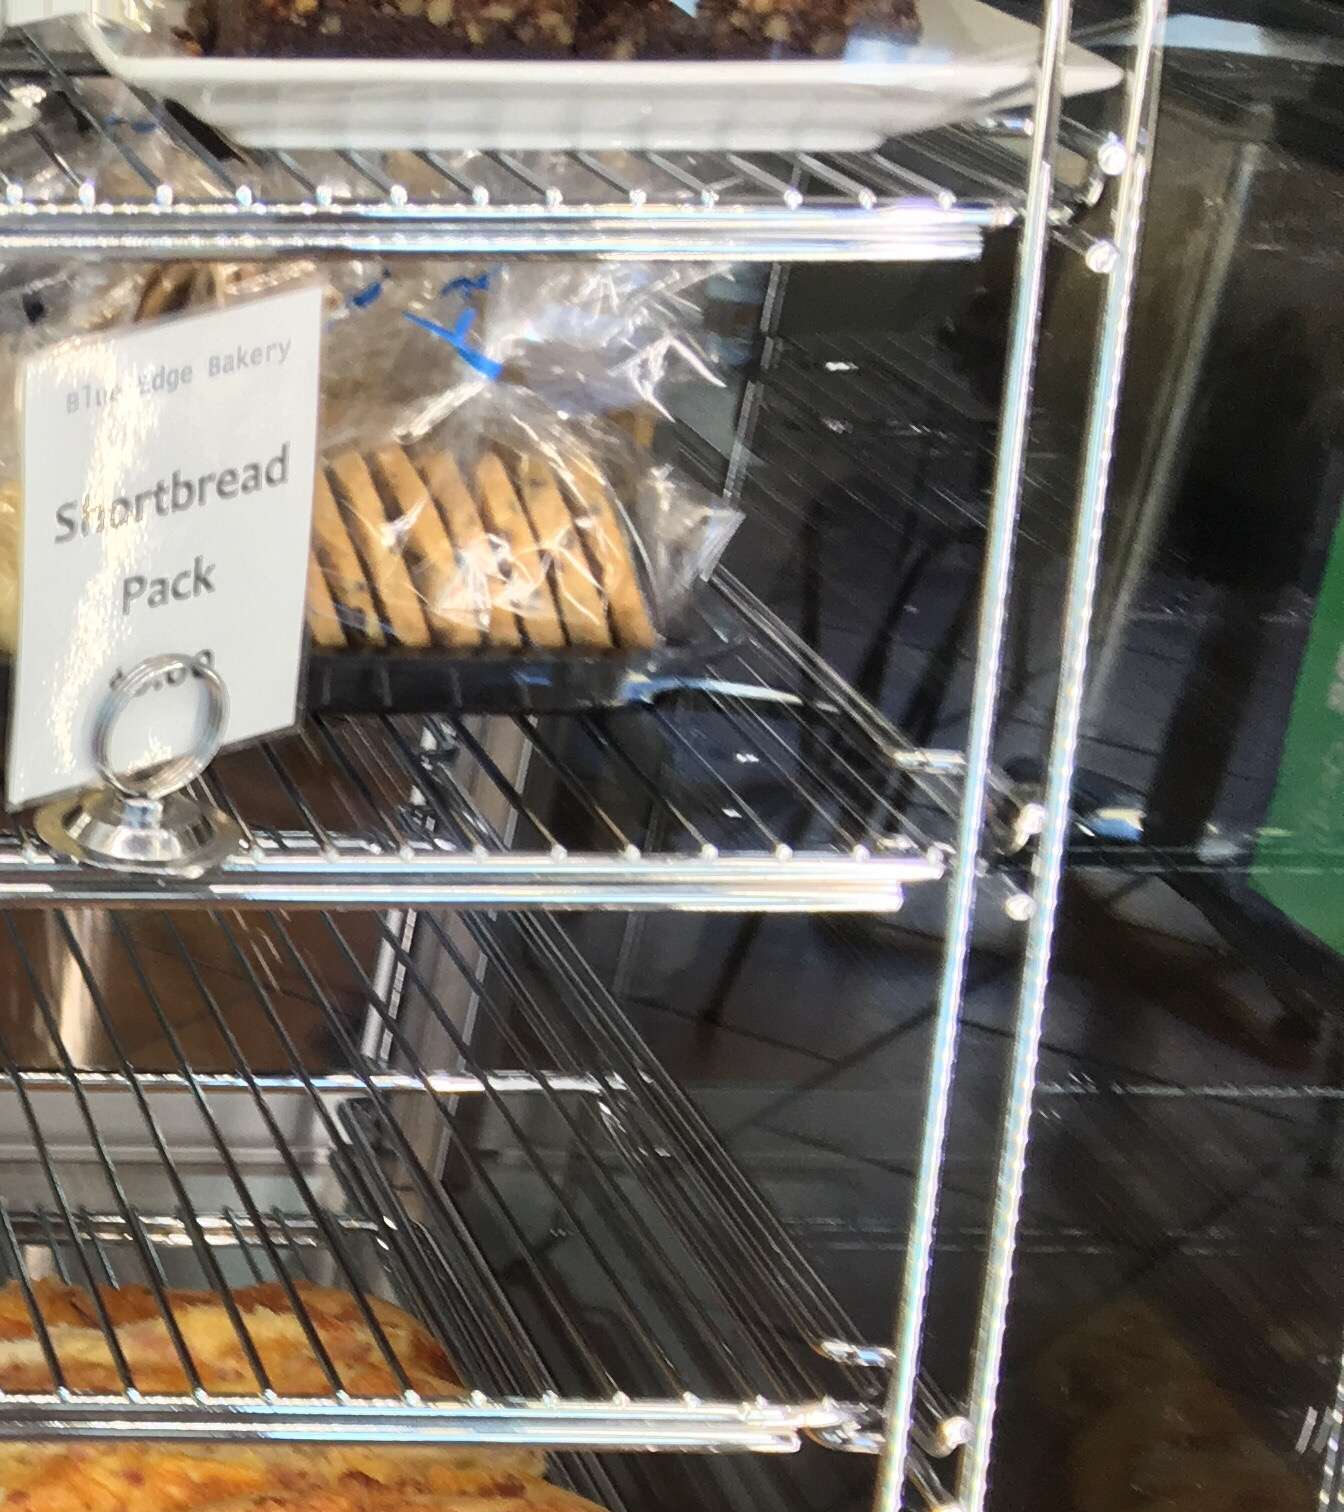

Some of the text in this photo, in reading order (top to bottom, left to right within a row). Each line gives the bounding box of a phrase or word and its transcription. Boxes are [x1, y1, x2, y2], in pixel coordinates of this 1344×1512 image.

[208, 338, 292, 378] Bakery
[54, 440, 291, 545] Shortbread
[120, 553, 217, 616] Pack
